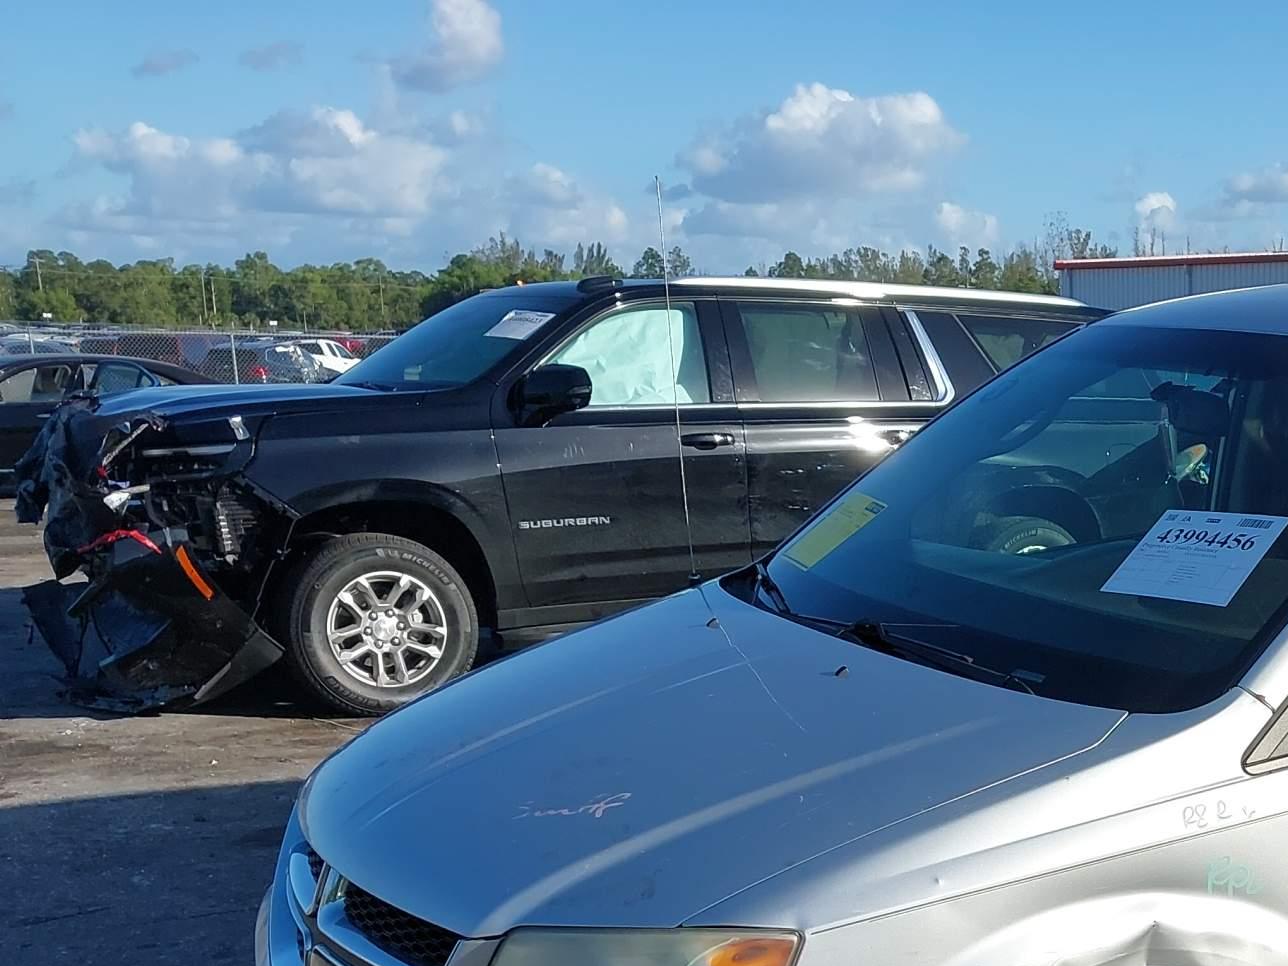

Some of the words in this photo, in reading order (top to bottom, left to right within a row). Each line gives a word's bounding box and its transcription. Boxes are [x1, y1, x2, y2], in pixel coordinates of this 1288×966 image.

[518, 516, 611, 529] SUBURBAN
[1156, 527, 1262, 551] 43994456
[401, 552, 450, 585] MICHELIN
